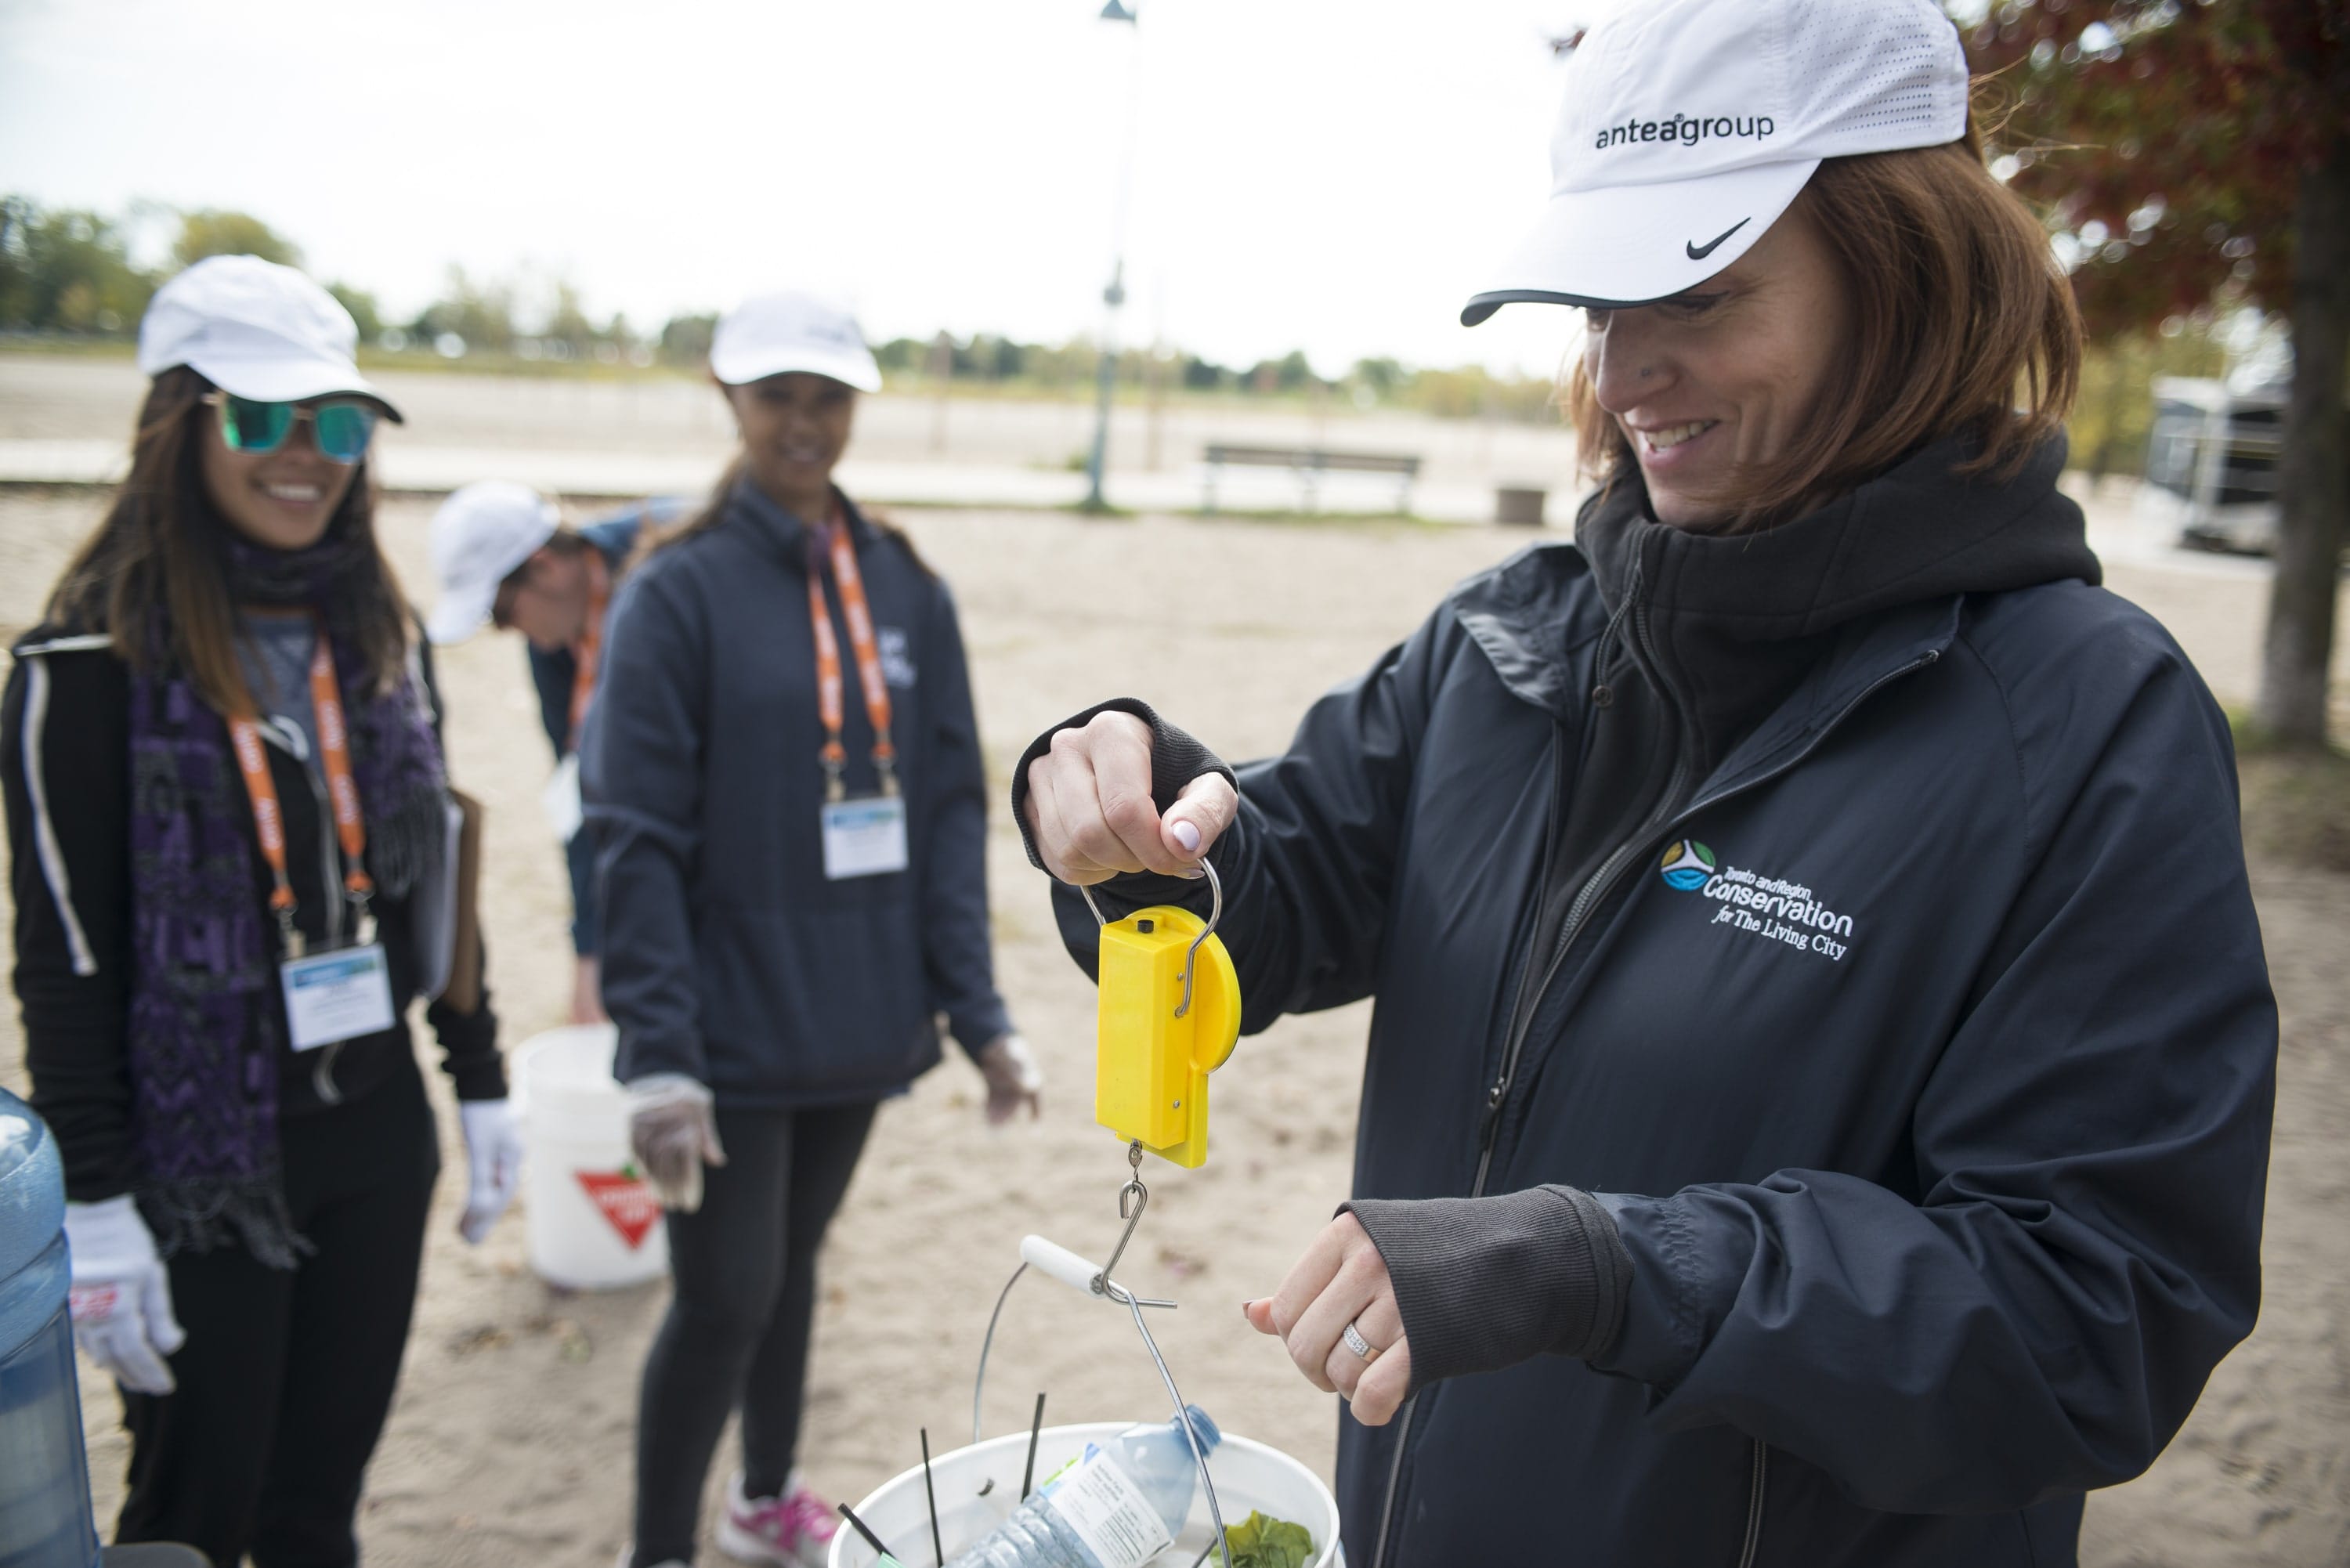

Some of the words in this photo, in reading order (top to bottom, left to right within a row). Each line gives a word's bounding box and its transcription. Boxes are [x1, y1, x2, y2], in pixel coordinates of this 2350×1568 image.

[1703, 873, 1853, 937] Conservation
[1723, 865, 1754, 884] Toronto
[1755, 876, 1780, 893] and
[1777, 880, 1812, 901] Region
[1711, 905, 1734, 924] for
[1734, 909, 1762, 931] The
[1761, 919, 1810, 950] Living
[1811, 934, 1847, 961] City
